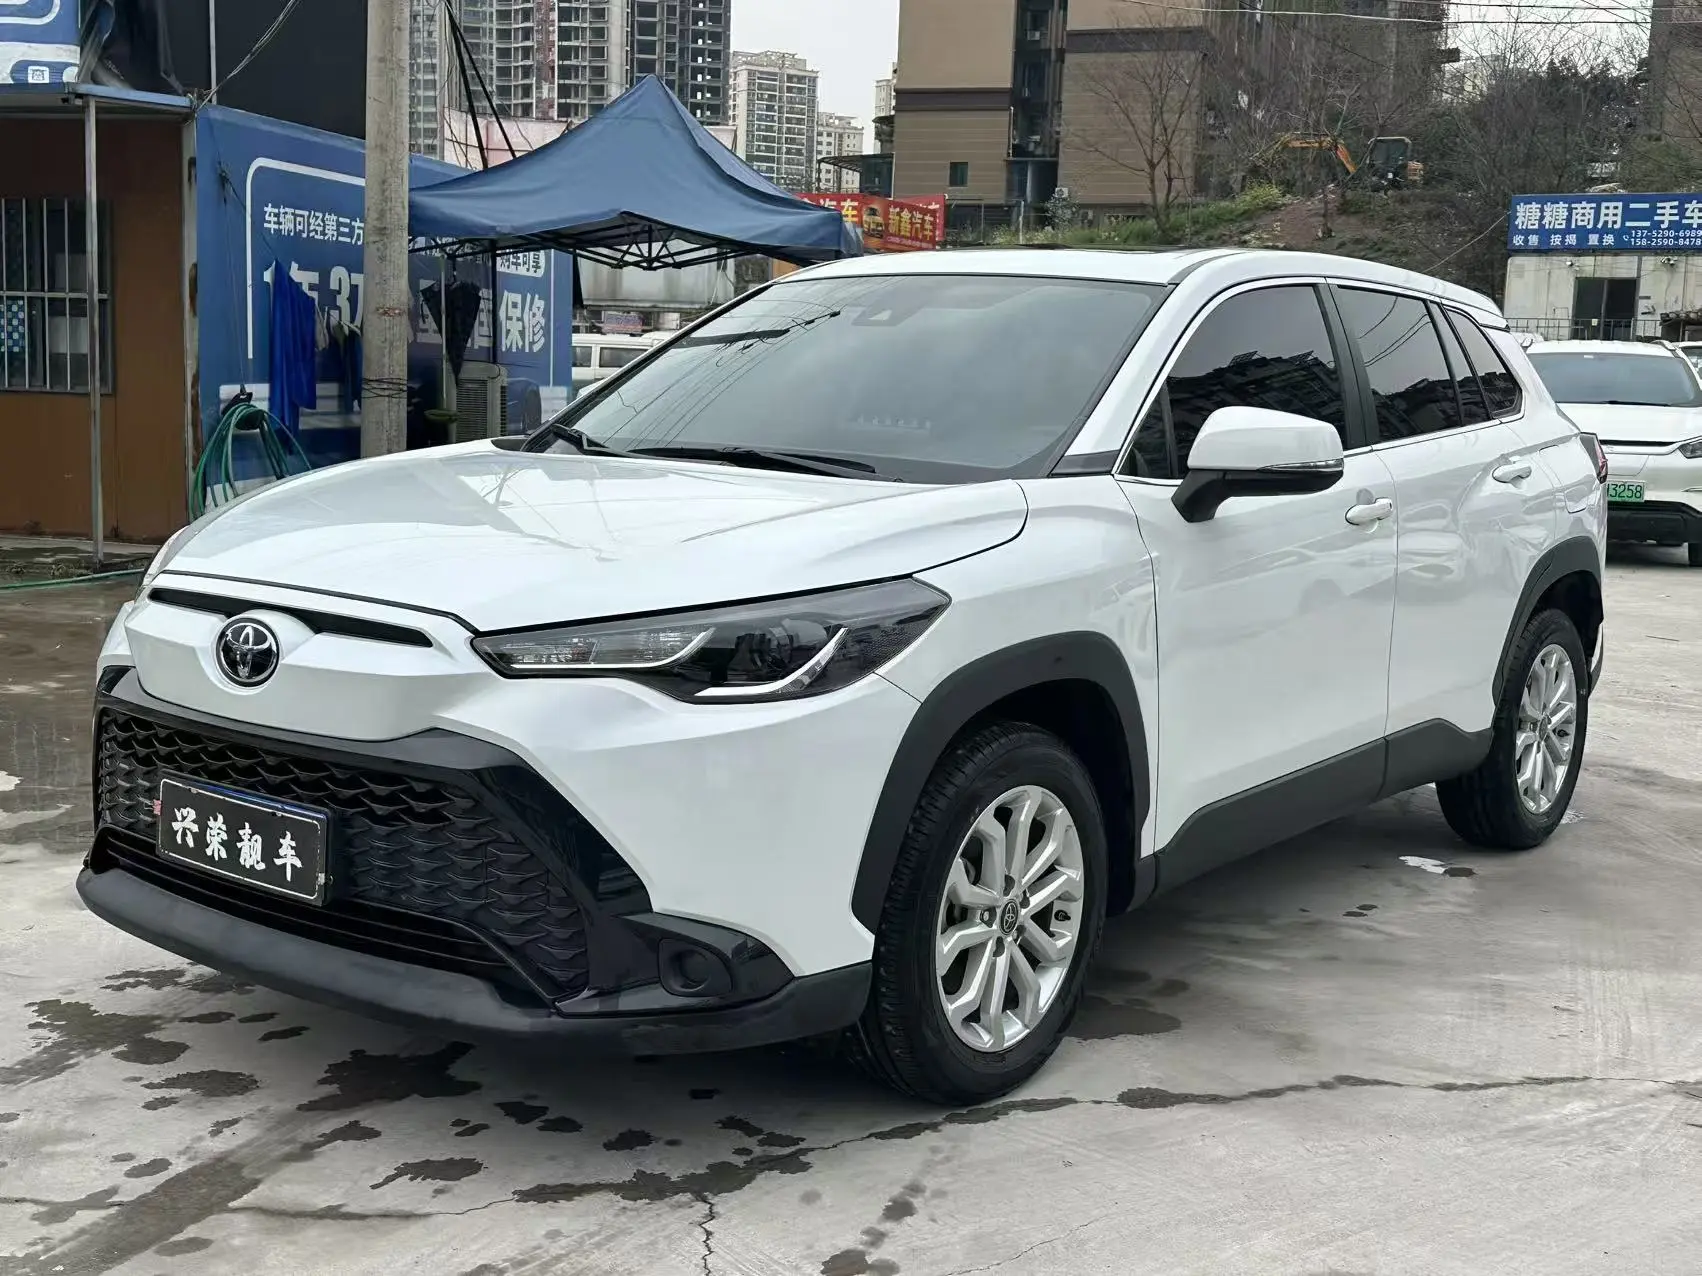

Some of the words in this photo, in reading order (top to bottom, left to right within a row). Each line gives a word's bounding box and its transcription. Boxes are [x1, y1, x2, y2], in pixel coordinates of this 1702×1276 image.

[263, 203, 365, 245] 车辆可经第三方
[1515, 200, 1702, 229] 糖糖商用二手车
[1513, 235, 1539, 246] 收售
[1550, 234, 1577, 246] 按揭
[1587, 234, 1615, 246] 置换
[1631, 238, 1702, 246] 158-2590-8478
[1607, 484, 1642, 499] 3258
[171, 806, 303, 882] 兴荣靓车
